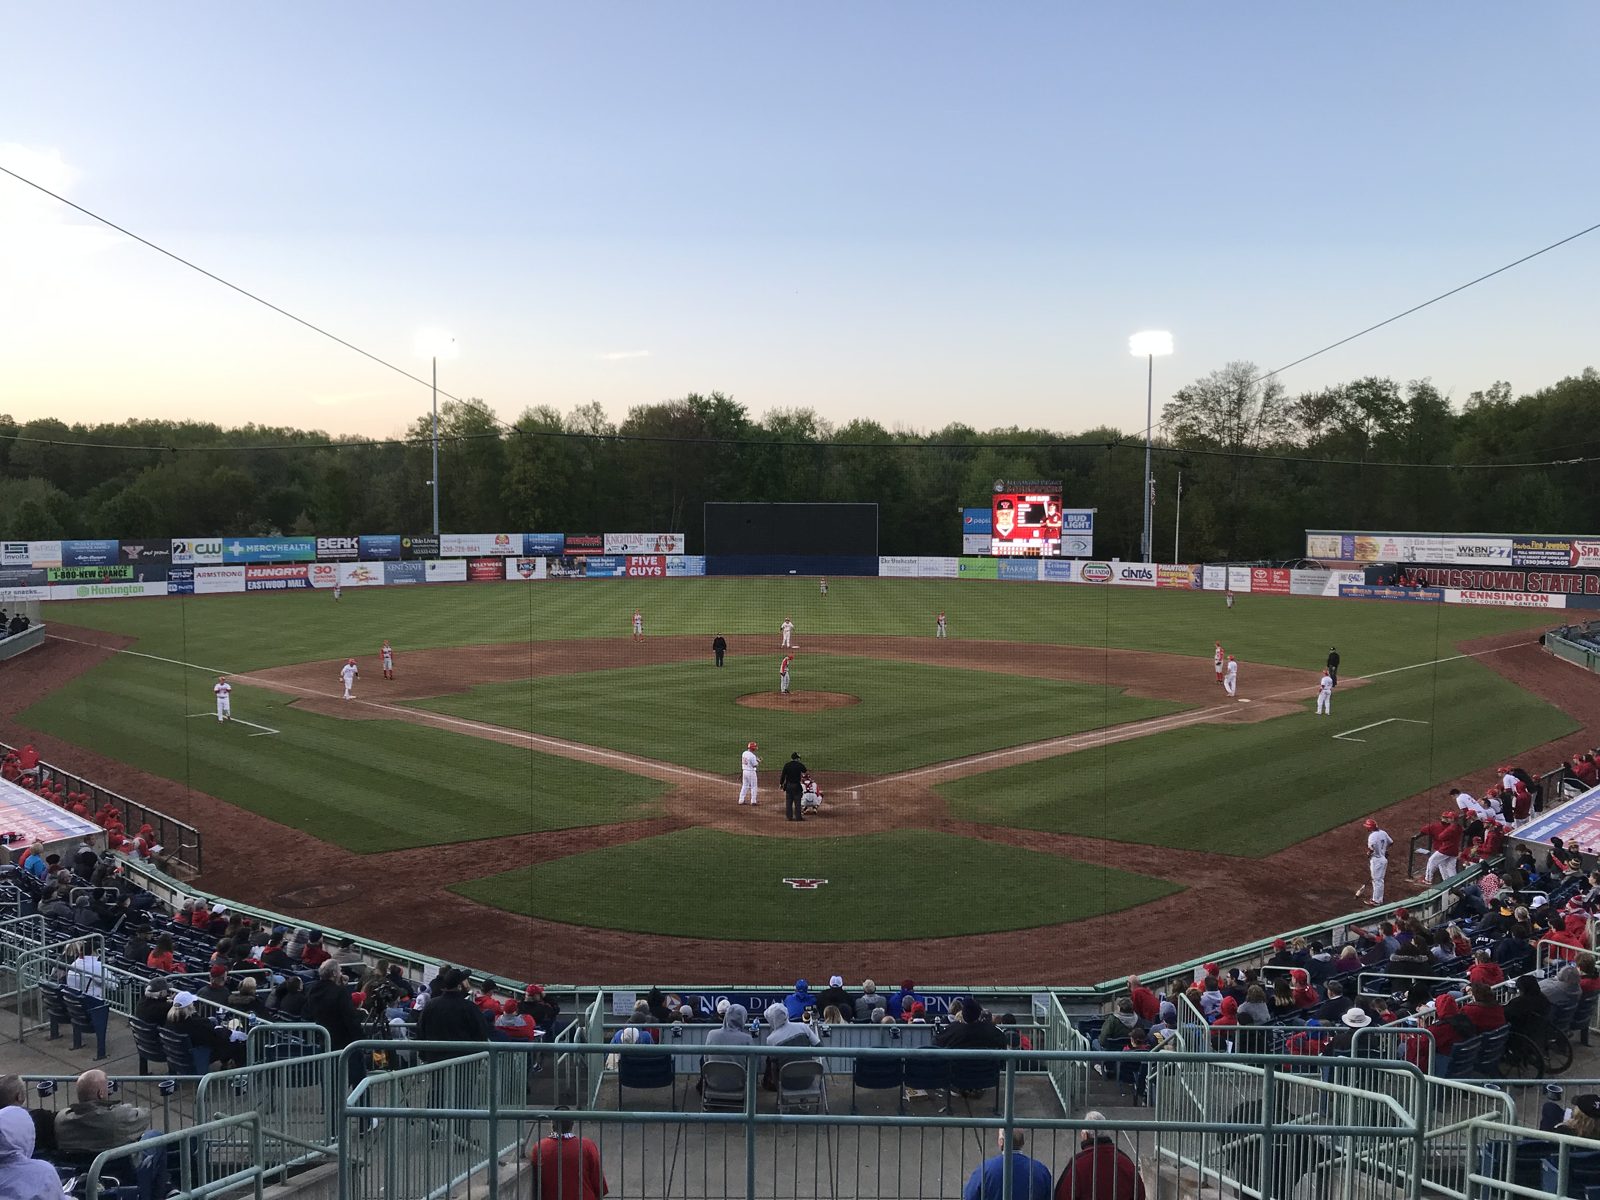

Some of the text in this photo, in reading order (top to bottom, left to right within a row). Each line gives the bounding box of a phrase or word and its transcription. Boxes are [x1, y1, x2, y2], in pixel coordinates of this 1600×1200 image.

[1064, 521, 1091, 529] LIGHT
[317, 538, 358, 549] BERK
[1489, 546, 1511, 558] 27
[631, 556, 658, 566] FIVE
[54, 571, 96, 579] 1-800-NEW
[97, 569, 128, 578] CHANCE
[248, 568, 307, 577] HUNGRY?
[629, 566, 661, 576] GUYS
[247, 579, 306, 590] EASTWOOD MALL
[1405, 568, 1600, 595] YOUNGSTOWN STATE B
[91, 585, 144, 596] Huntington
[1460, 591, 1549, 602] KENNSINGTON
